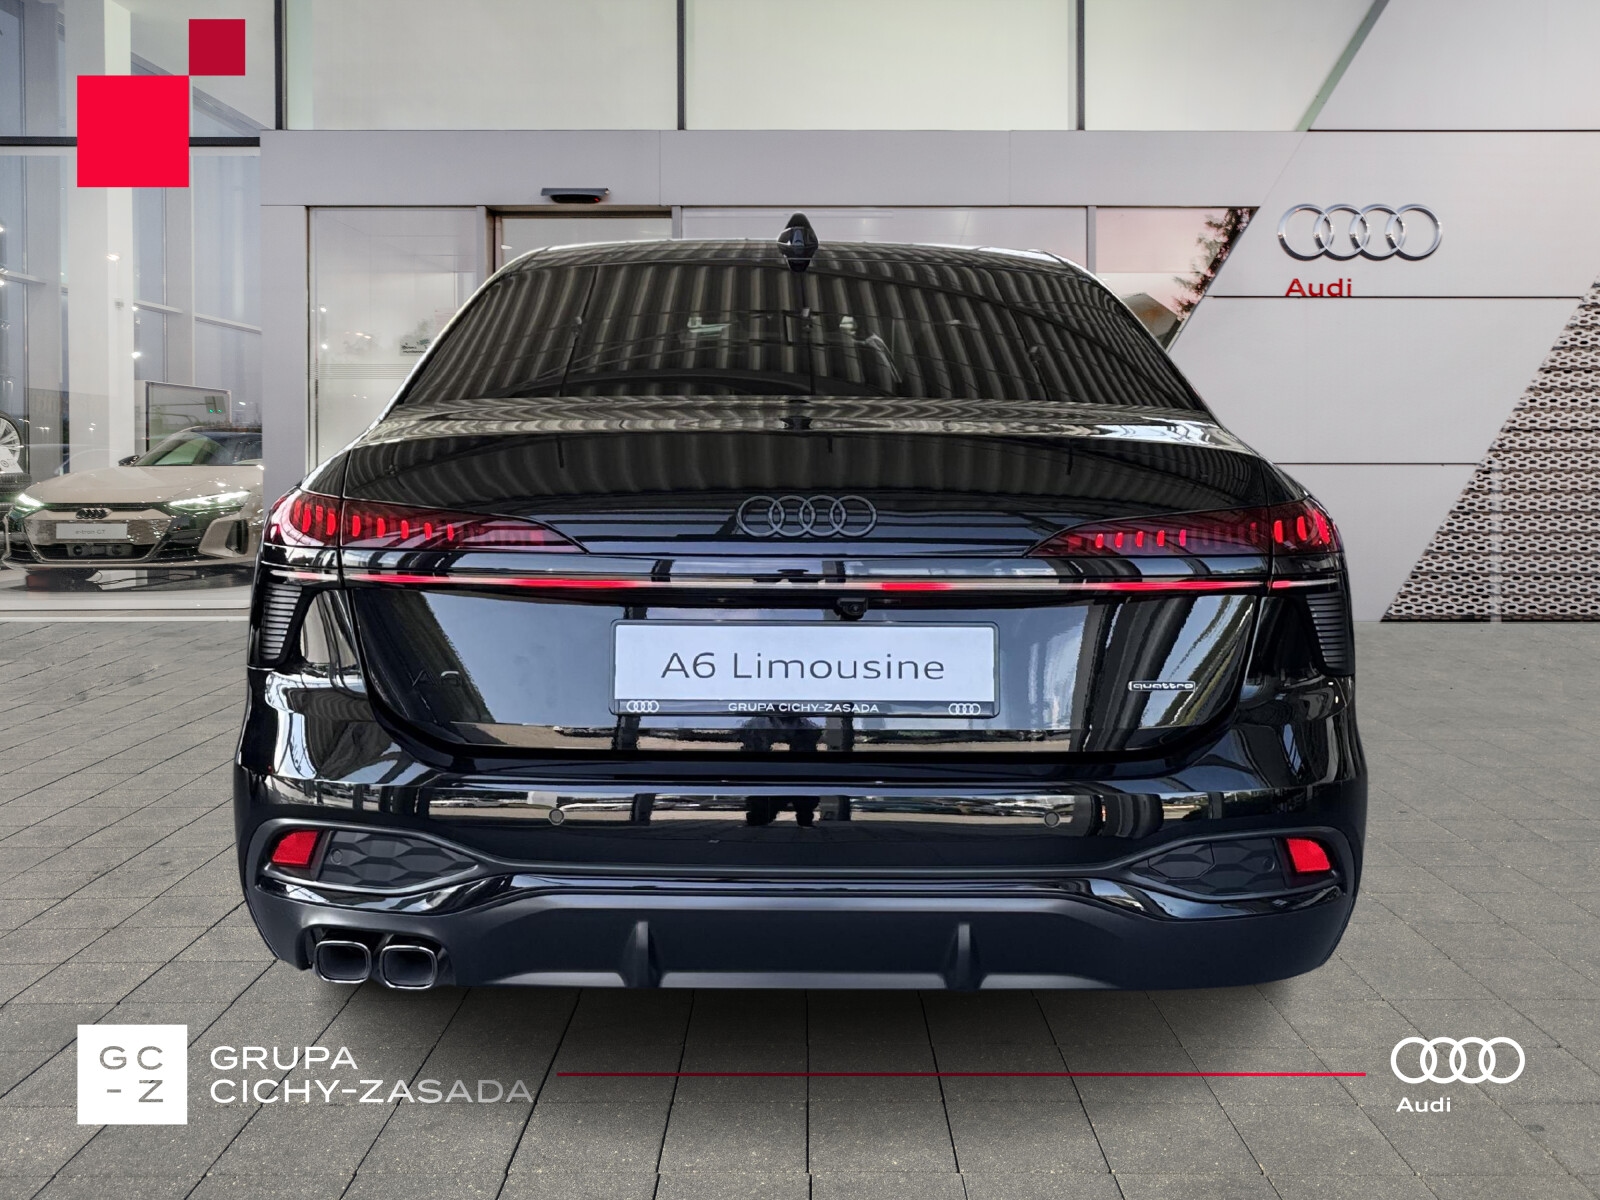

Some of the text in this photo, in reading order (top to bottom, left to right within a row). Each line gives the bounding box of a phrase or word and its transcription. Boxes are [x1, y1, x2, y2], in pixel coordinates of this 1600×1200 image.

[1285, 278, 1352, 297] Audi
[661, 652, 945, 680] A6 Limousine
[728, 702, 879, 713] GRUPA CICHY-ZASADA
